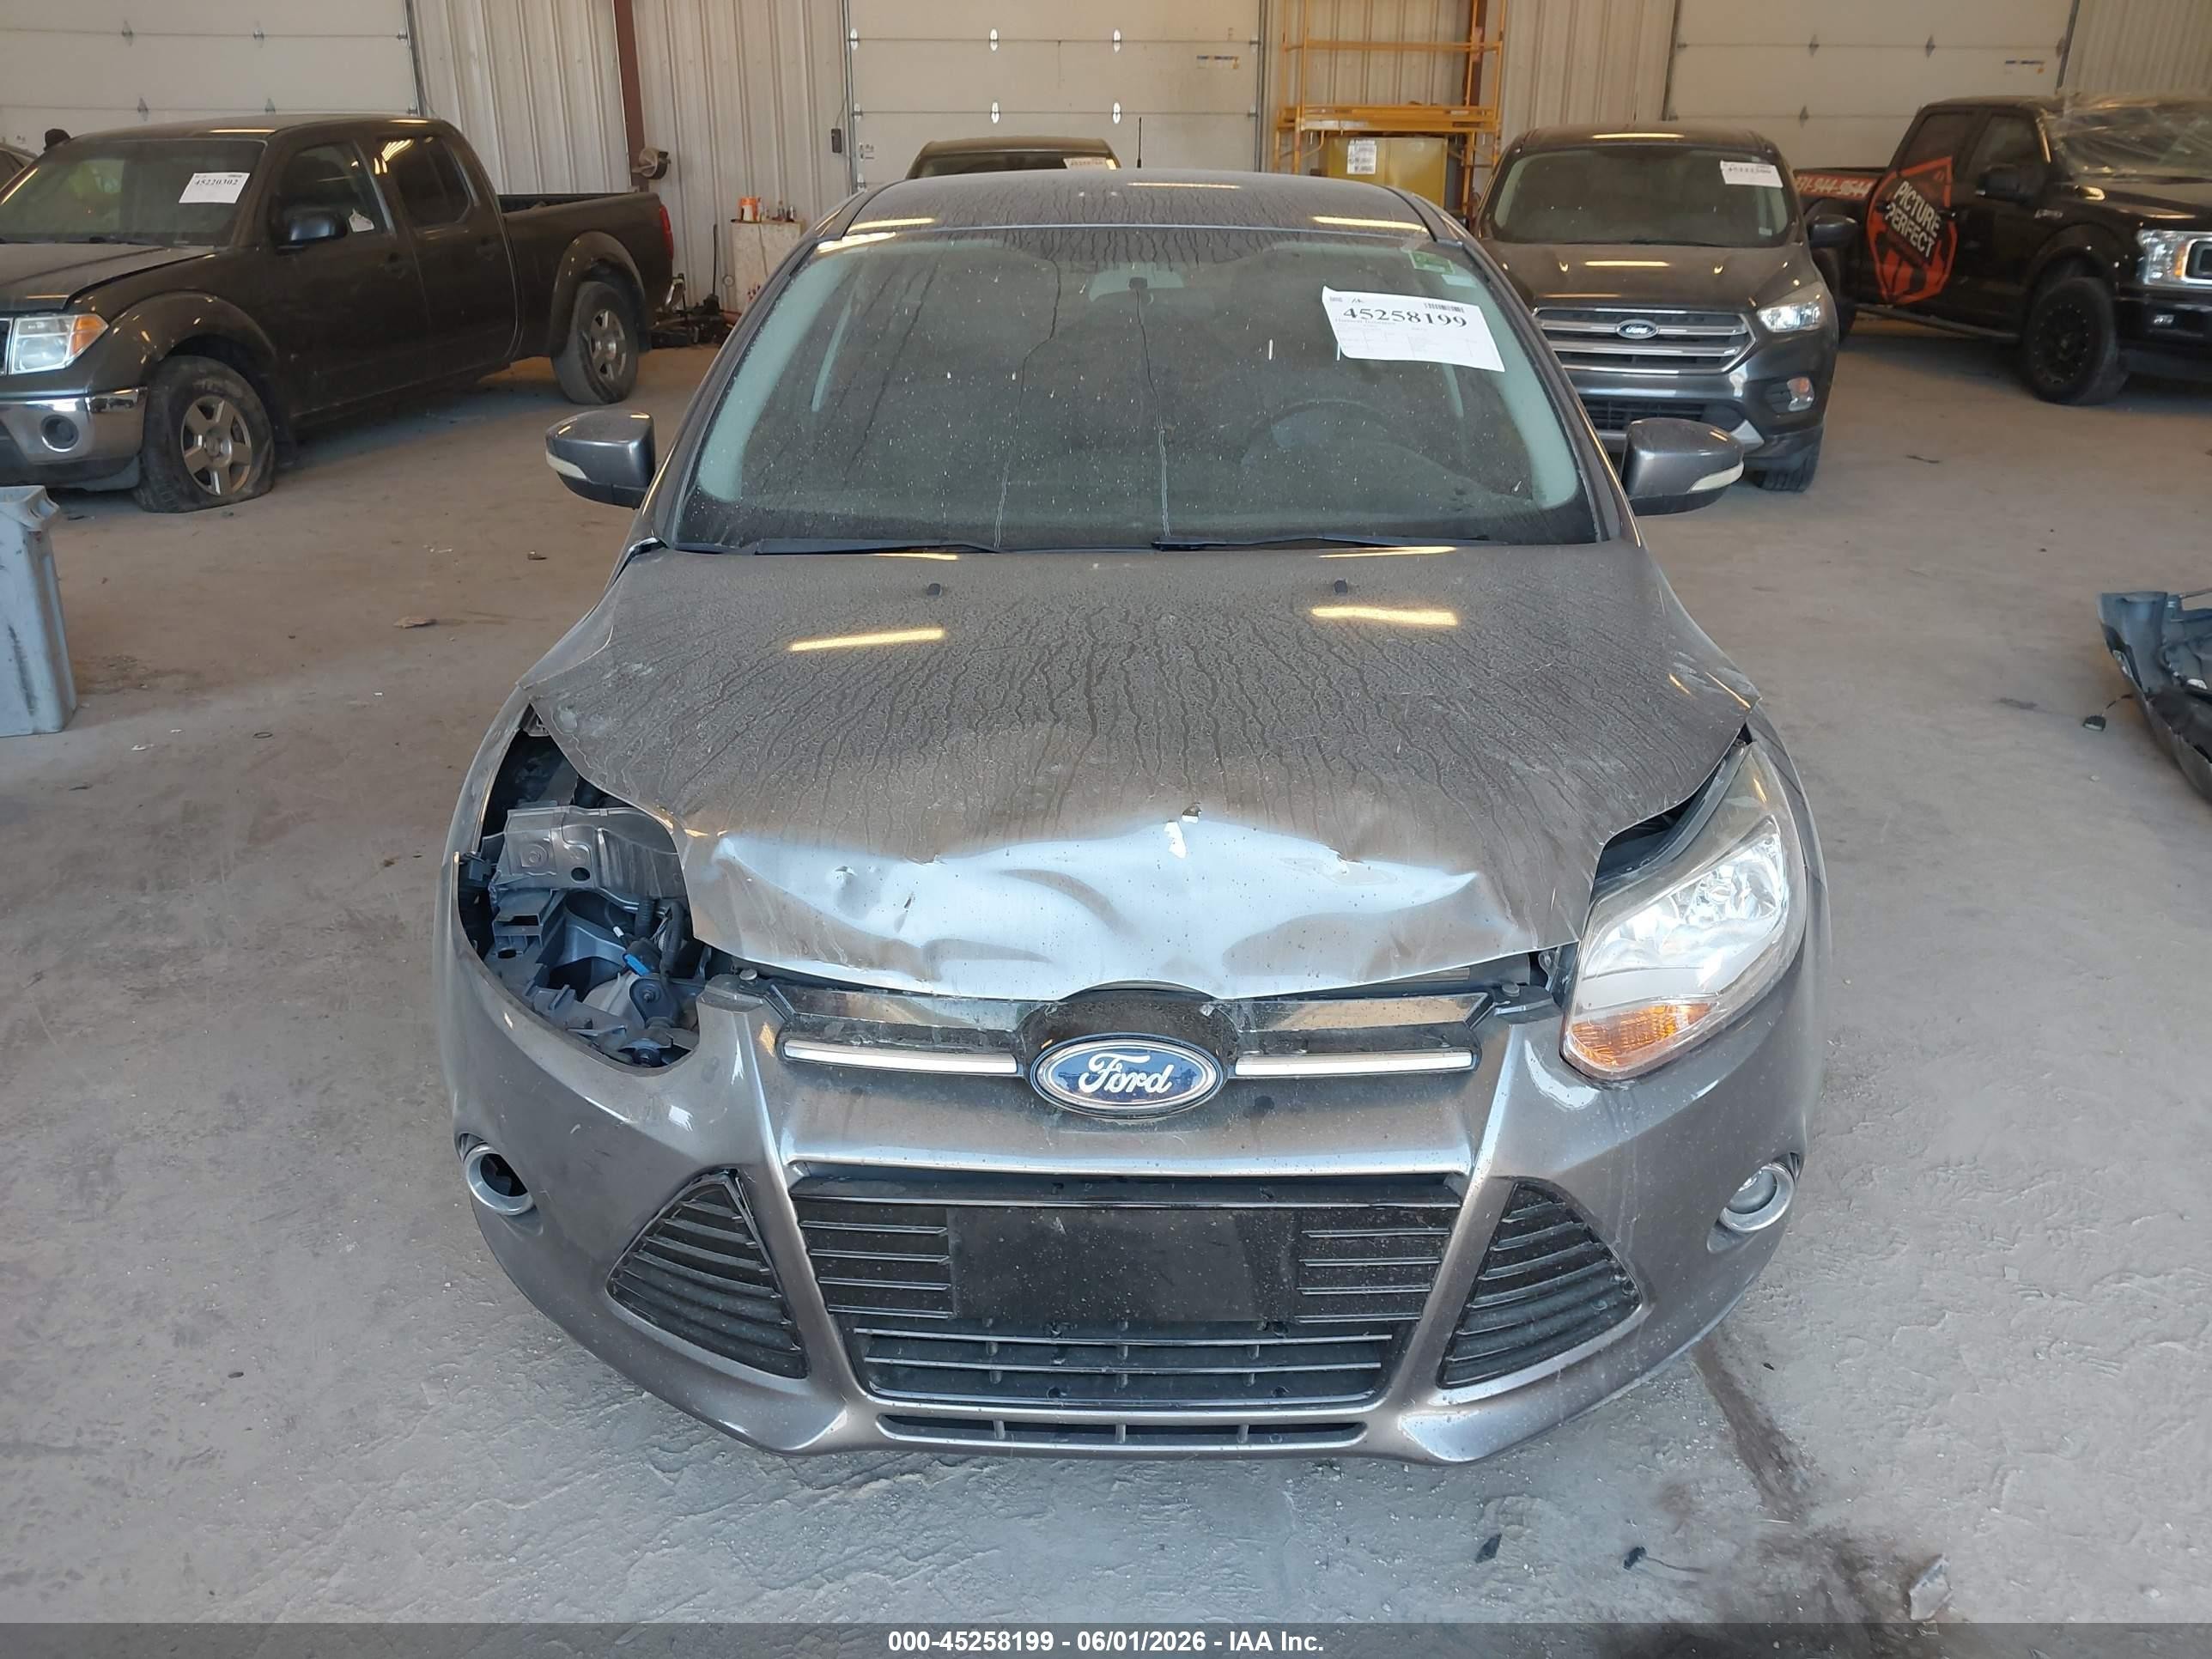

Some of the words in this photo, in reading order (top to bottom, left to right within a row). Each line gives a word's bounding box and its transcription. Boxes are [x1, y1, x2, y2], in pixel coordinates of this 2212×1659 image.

[1885, 202, 1936, 258] PERFECT
[1893, 180, 1942, 238] PICTURE
[1343, 307, 1467, 328] 45258199
[1079, 1053, 1174, 1093] Ford
